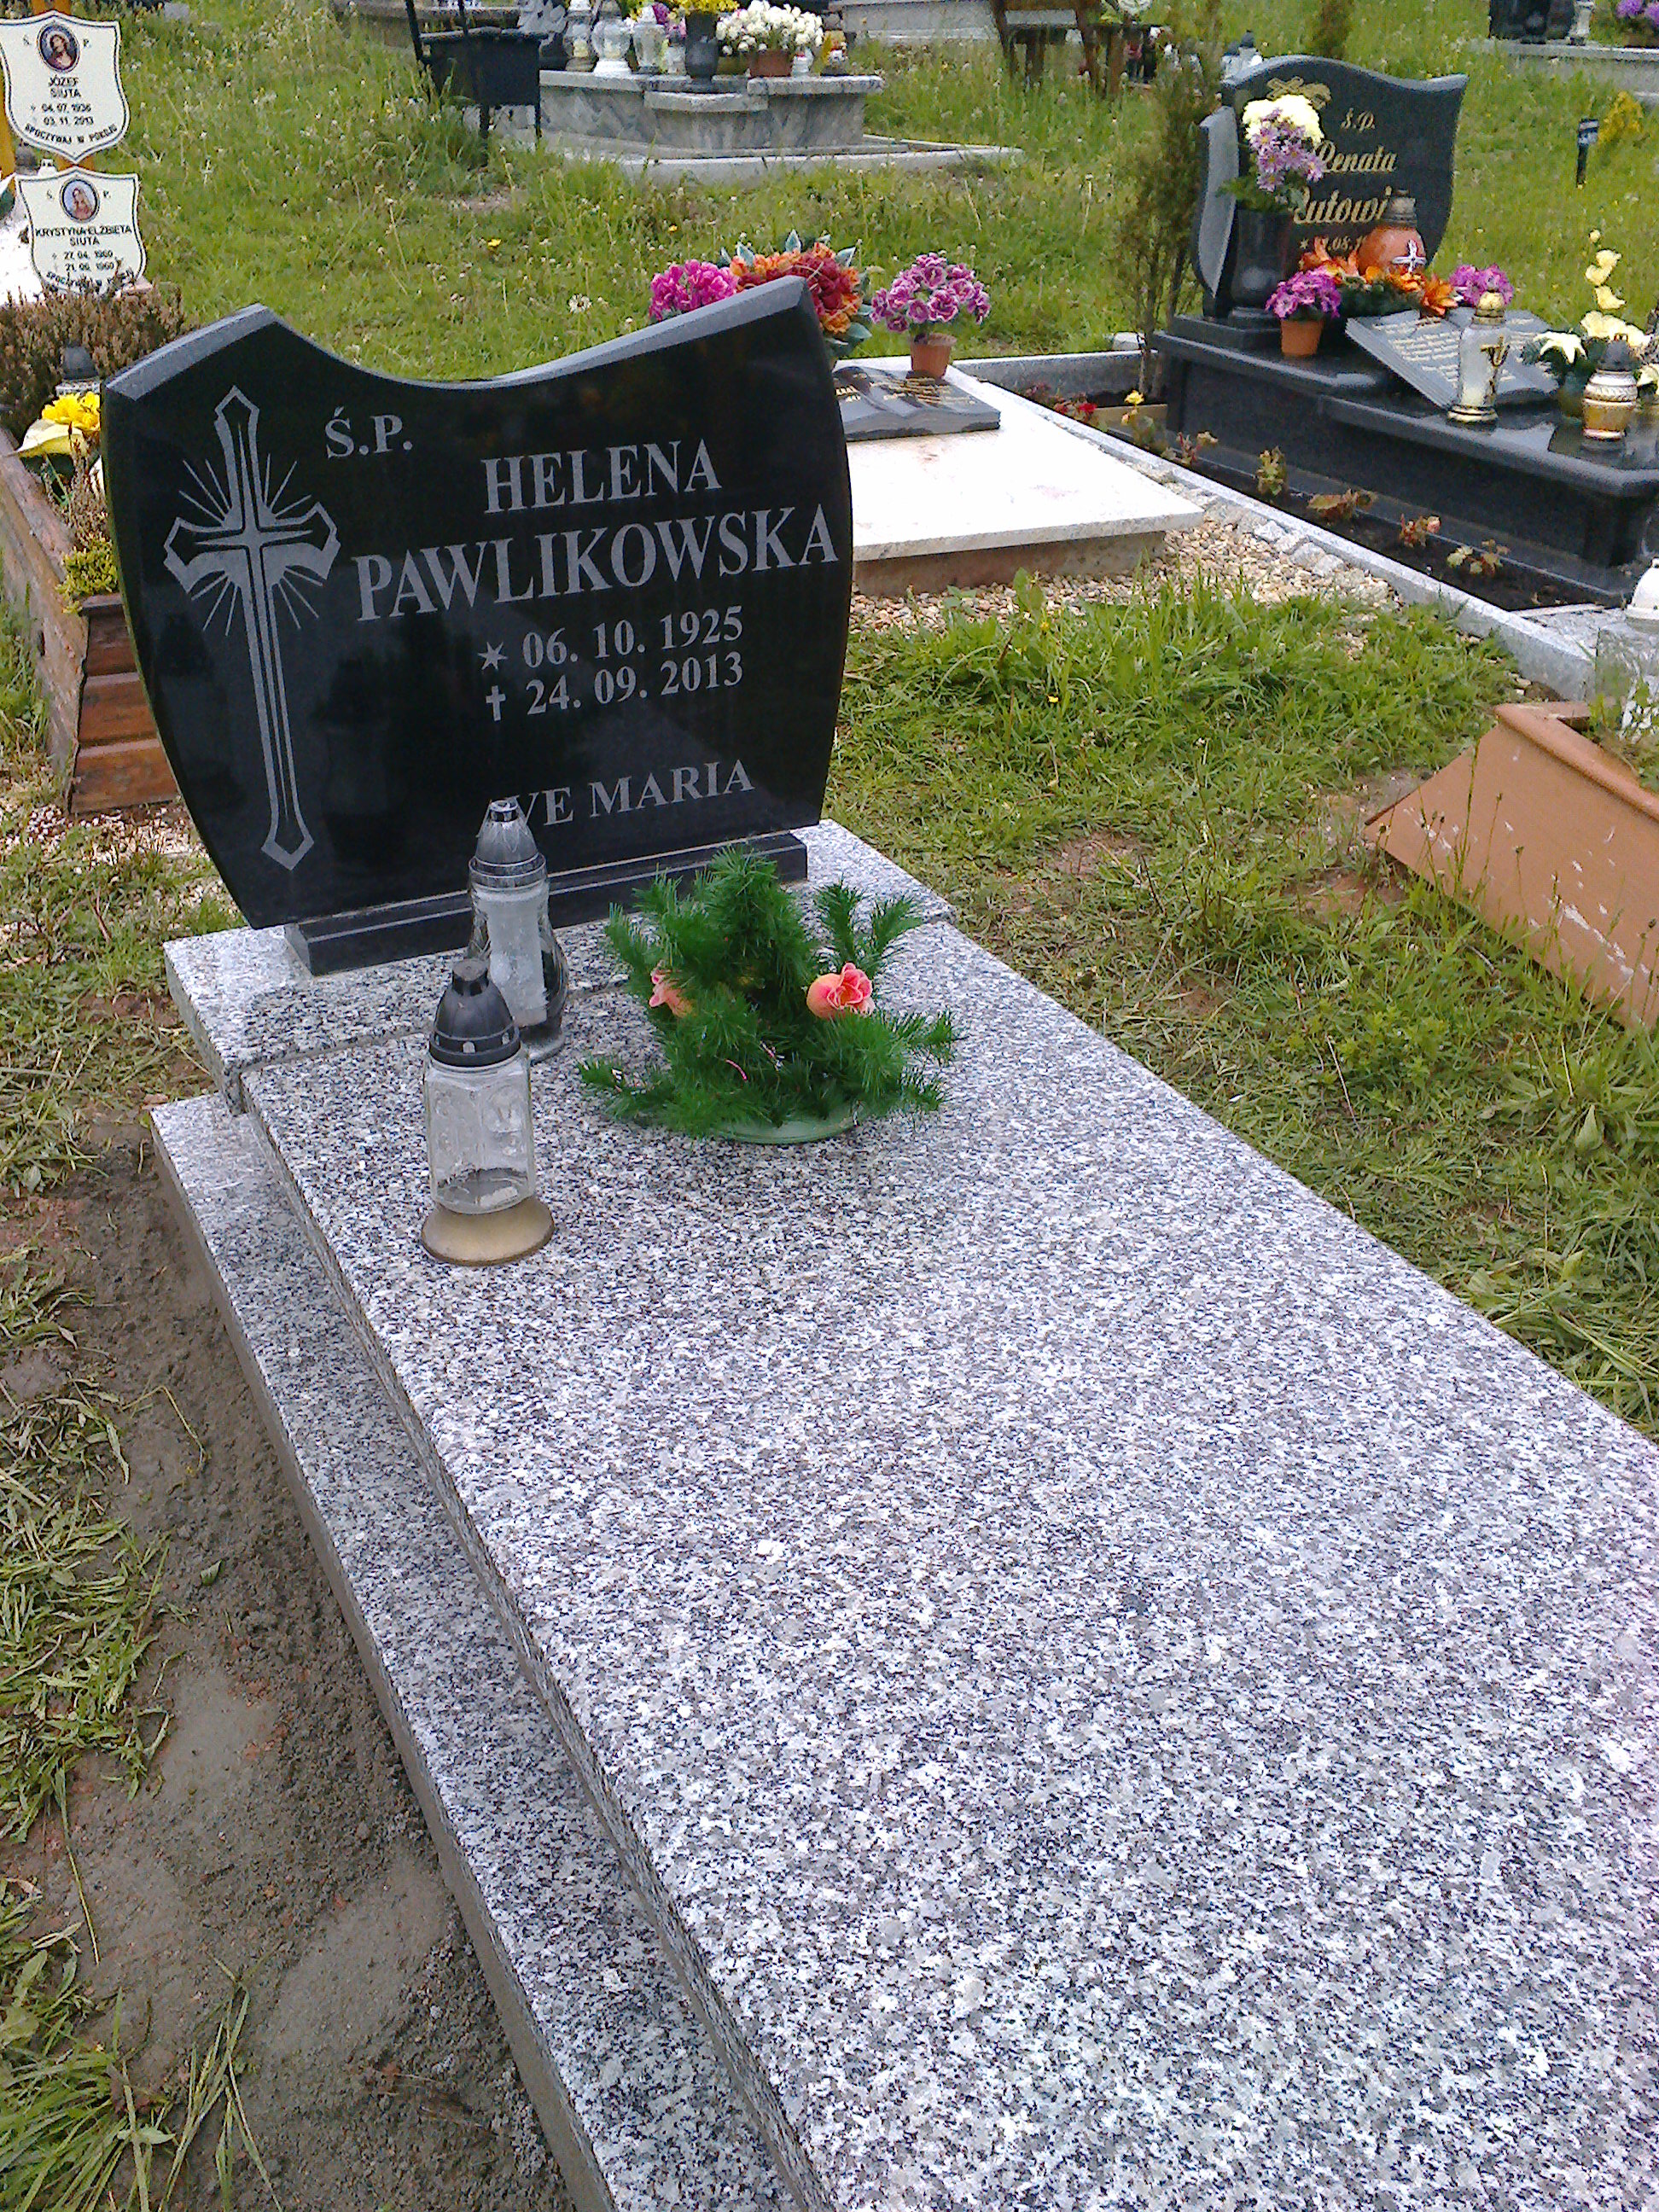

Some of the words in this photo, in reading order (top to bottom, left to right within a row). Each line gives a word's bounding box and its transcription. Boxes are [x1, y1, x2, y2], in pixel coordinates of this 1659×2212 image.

[50, 88, 82, 98] SIUTA
[35, 226, 86, 237] KRYSTYNA
[69, 237, 100, 247] SIUTA
[480, 439, 723, 514] HELENA
[351, 503, 839, 621] PAWLIKOWSKA
[522, 628, 579, 669] 06.
[595, 619, 645, 660] 10.
[661, 605, 743, 650] 1925
[526, 675, 582, 716] 24.
[596, 665, 648, 706] 09.
[661, 651, 743, 696] 2013
[588, 760, 755, 818] MARIA
